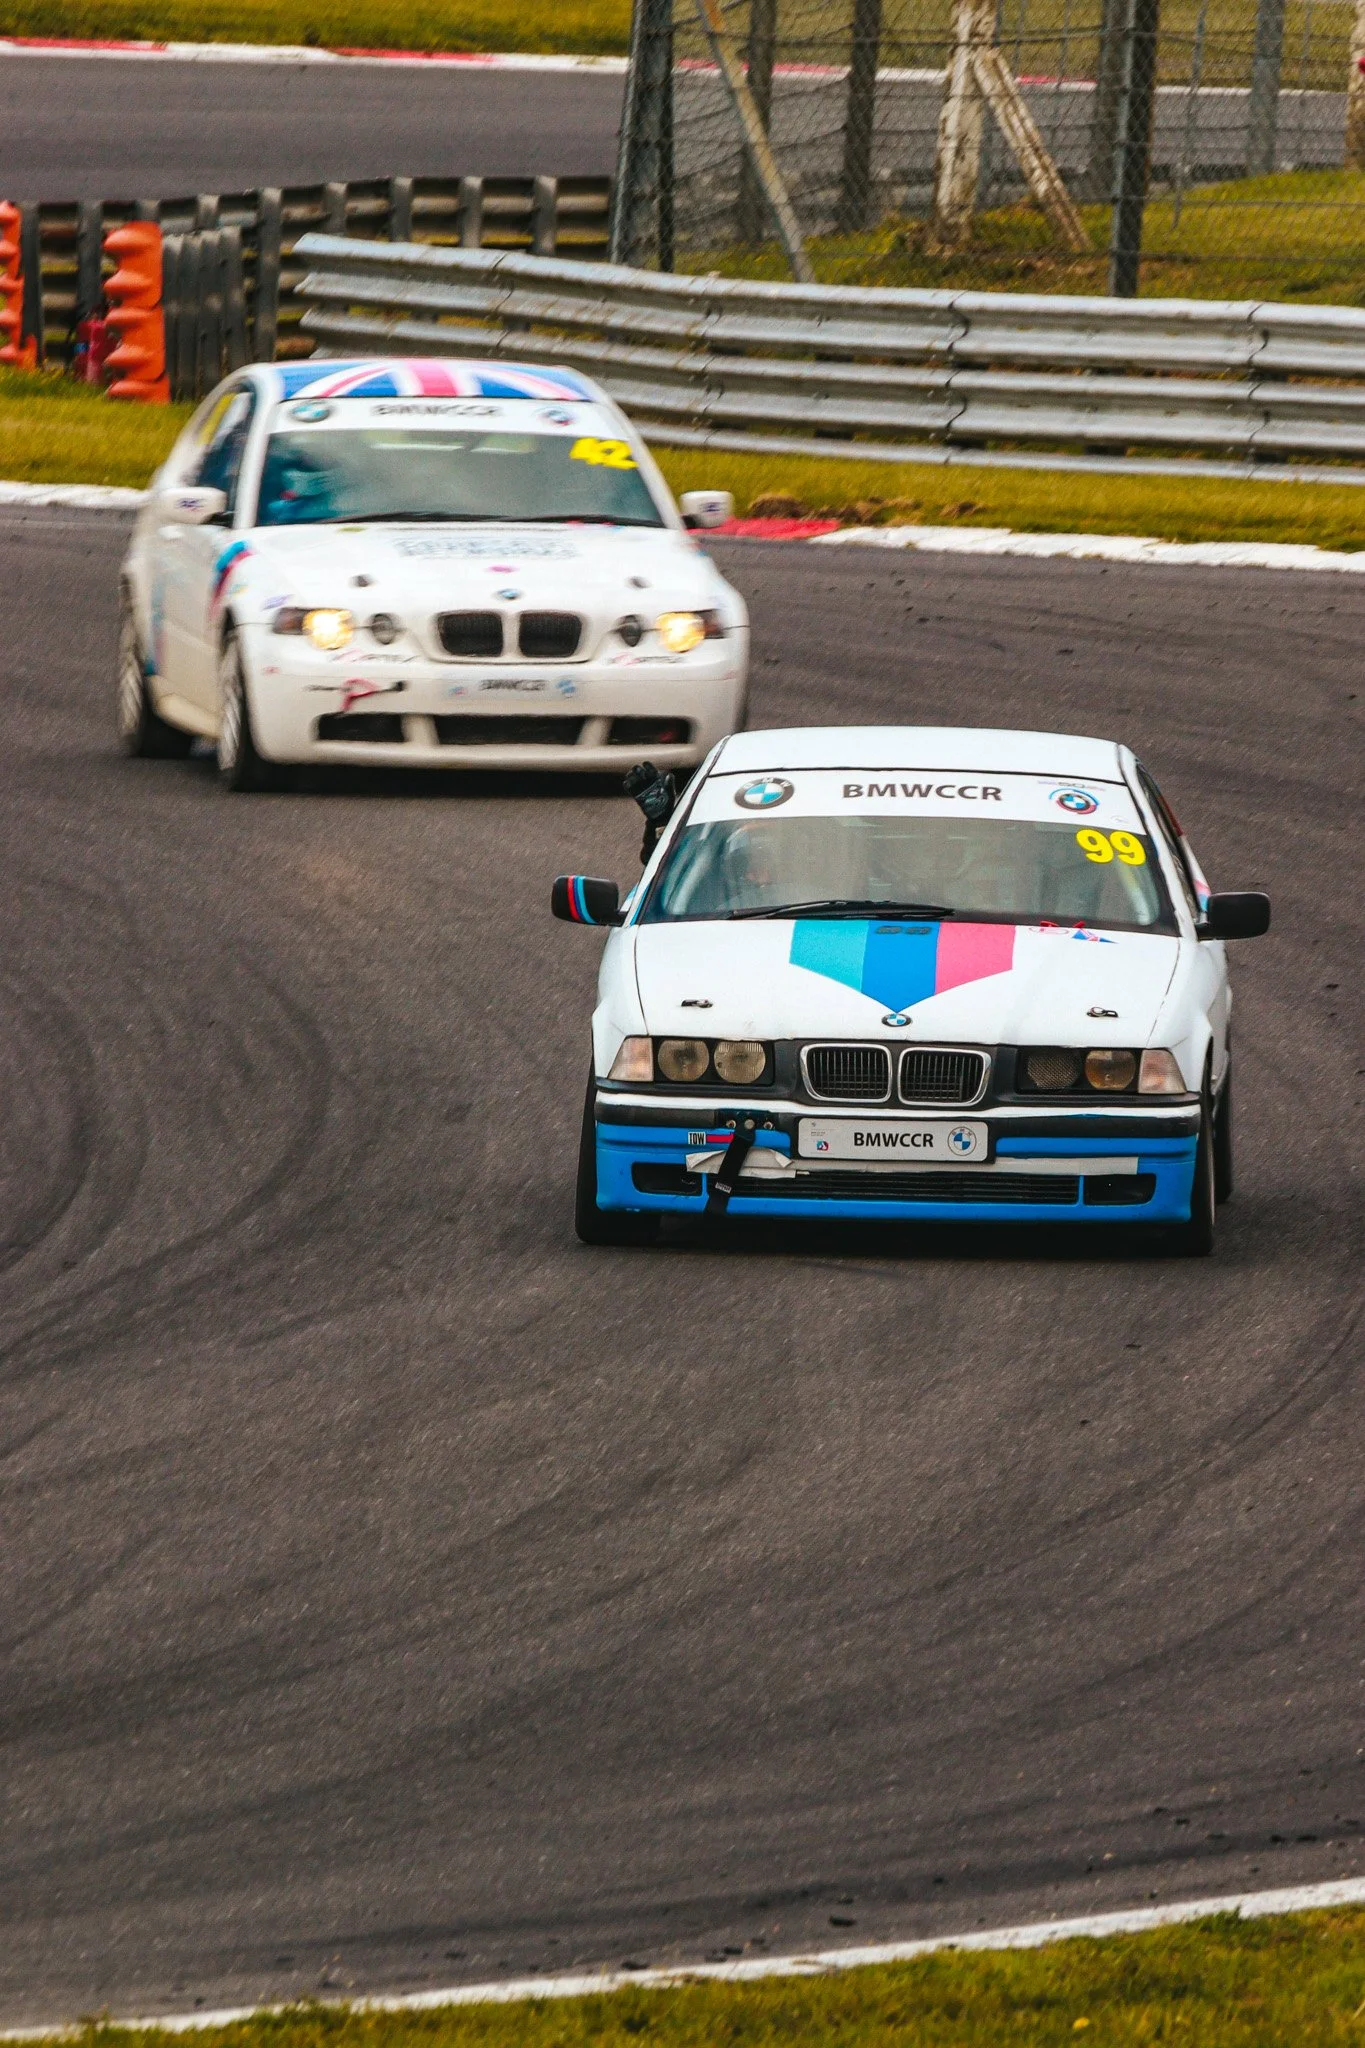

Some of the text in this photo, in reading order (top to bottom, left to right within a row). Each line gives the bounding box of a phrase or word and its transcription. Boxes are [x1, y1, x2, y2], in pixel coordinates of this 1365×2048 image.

[570, 437, 638, 470] 42
[842, 783, 1002, 801] BMWCCR
[1076, 828, 1147, 867] 99
[688, 1132, 706, 1145] TOW
[853, 1131, 935, 1148] BMWCCR
